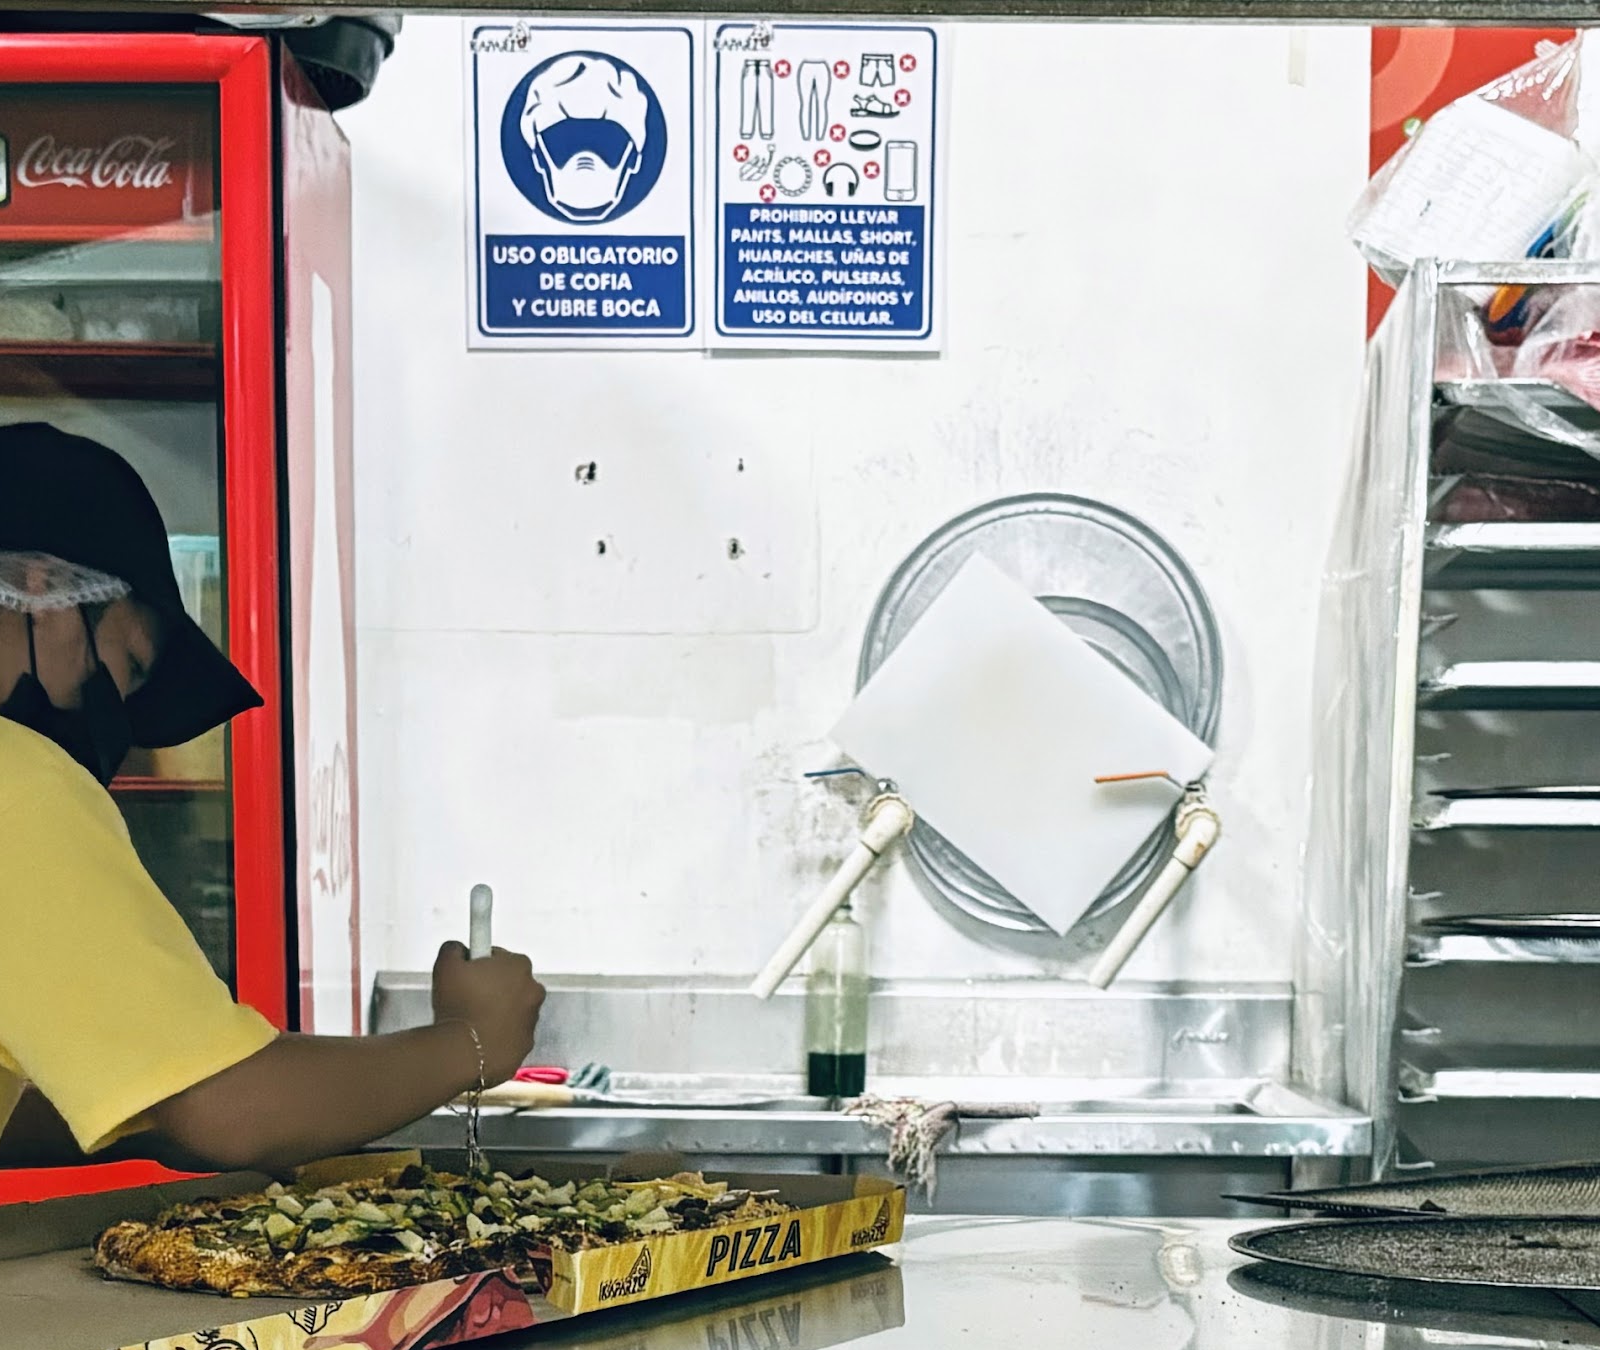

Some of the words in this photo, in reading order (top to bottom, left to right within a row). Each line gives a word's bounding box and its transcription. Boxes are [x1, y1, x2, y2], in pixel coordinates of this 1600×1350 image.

[750, 208, 837, 224] PROHIBIDO
[840, 210, 898, 224] LLEVAR
[731, 228, 785, 244] PANTS,
[789, 229, 857, 245] MALLAS,
[859, 230, 917, 247] SHORT,
[493, 246, 536, 264] USO
[540, 246, 679, 265] OBLIGATORIO
[738, 249, 838, 265] HUARACHES,
[841, 248, 885, 265] UÑAS
[888, 251, 909, 265] DE
[539, 272, 565, 290] DE
[570, 272, 633, 291] COFIA
[742, 266, 819, 285] ACRÍLICO,
[822, 270, 905, 286] PULSERAS,
[733, 289, 803, 305] ANILLOS,
[806, 287, 898, 306] AUDÍFONOS
[902, 291, 914, 306] Y
[512, 298, 526, 317] Y
[530, 299, 597, 317] CUBRE
[602, 298, 661, 317] BOCA
[752, 309, 786, 324] USO
[789, 310, 817, 324] DEL
[820, 310, 894, 325] CELULAR.
[706, 1219, 801, 1277] PIZZA
